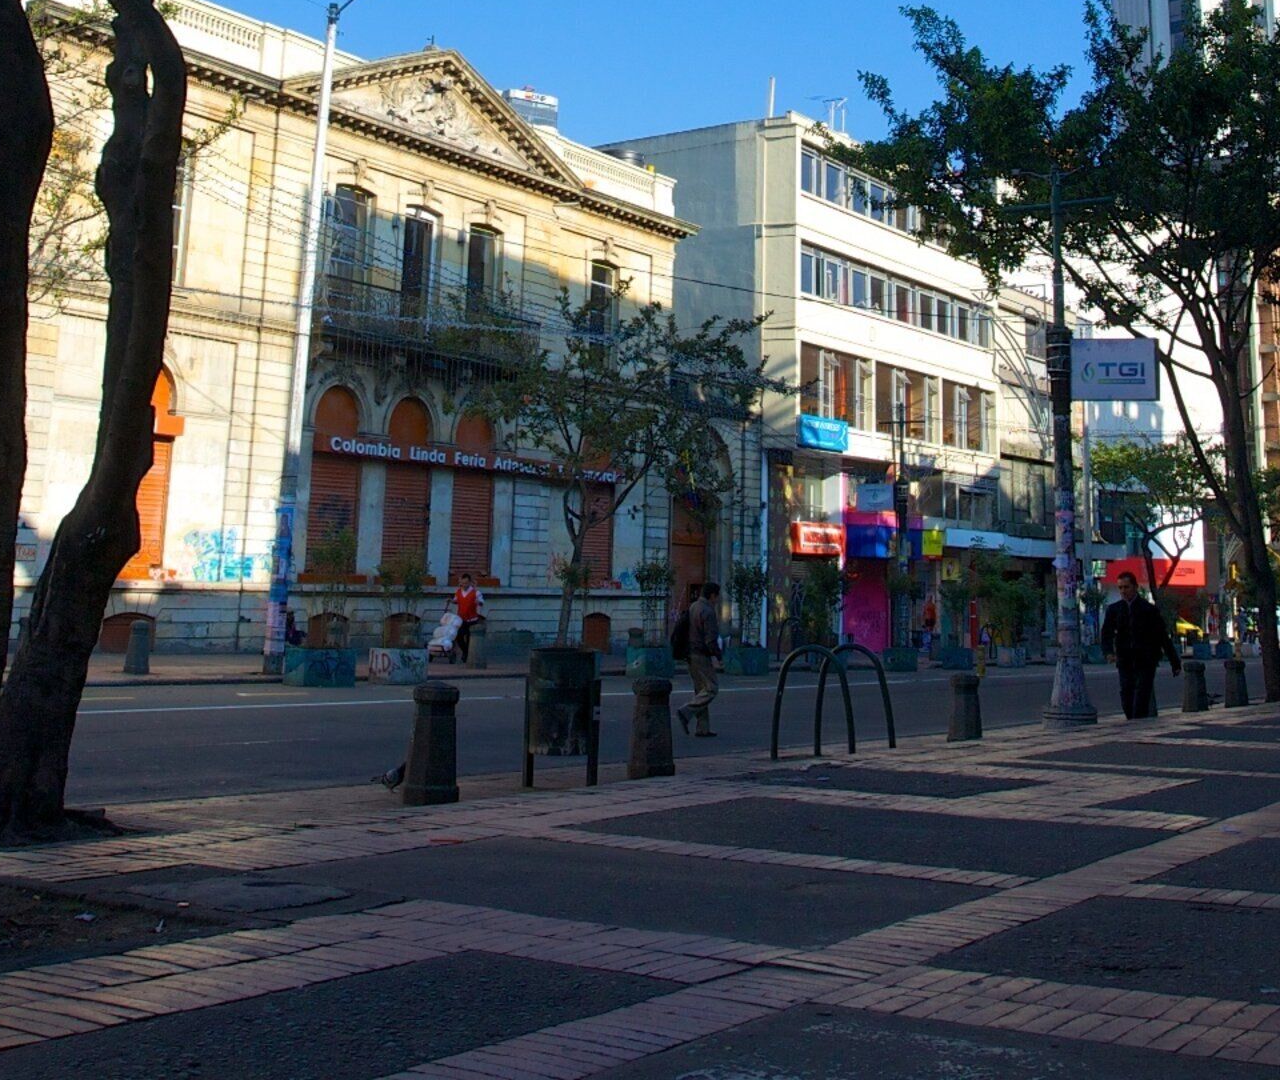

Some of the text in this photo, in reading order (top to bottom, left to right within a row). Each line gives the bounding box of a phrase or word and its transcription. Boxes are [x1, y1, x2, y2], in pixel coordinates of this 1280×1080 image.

[1098, 362, 1145, 377] TGI
[330, 436, 401, 459] Colombia
[410, 445, 447, 464] Linda
[455, 451, 487, 468] Feria
